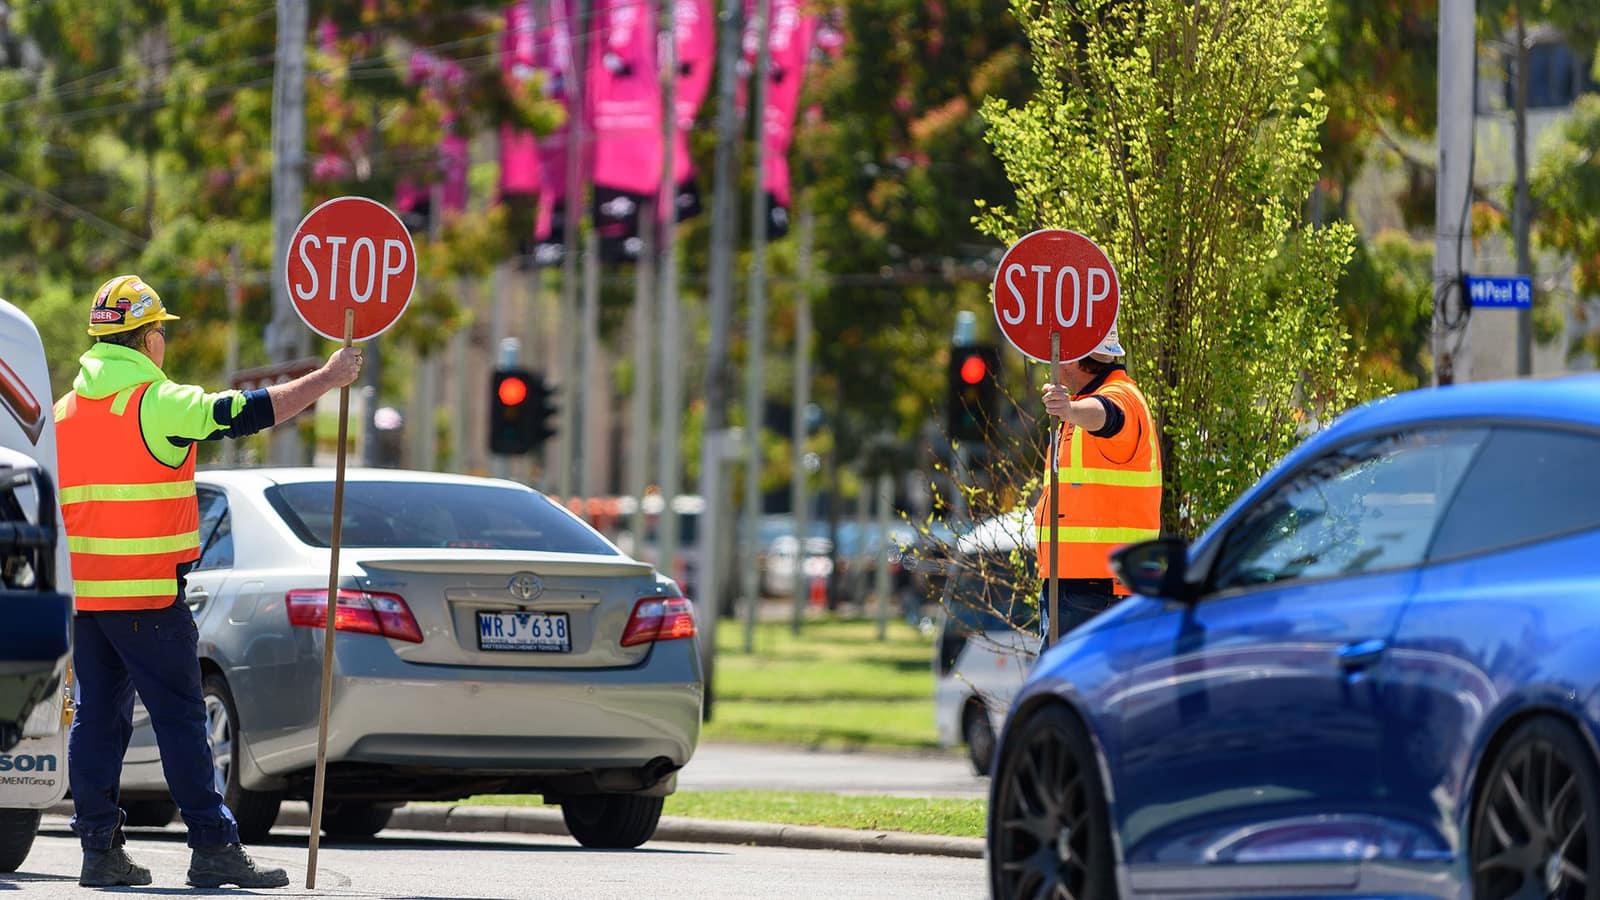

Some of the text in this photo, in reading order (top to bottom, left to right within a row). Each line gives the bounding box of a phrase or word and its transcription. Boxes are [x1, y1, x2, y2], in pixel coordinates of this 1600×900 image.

[295, 234, 407, 304] STOP
[1002, 263, 1111, 328] STOP
[1485, 280, 1513, 303] Peel
[1515, 280, 1530, 303] St
[480, 616, 566, 639] WRJ 638
[0, 754, 57, 771] son
